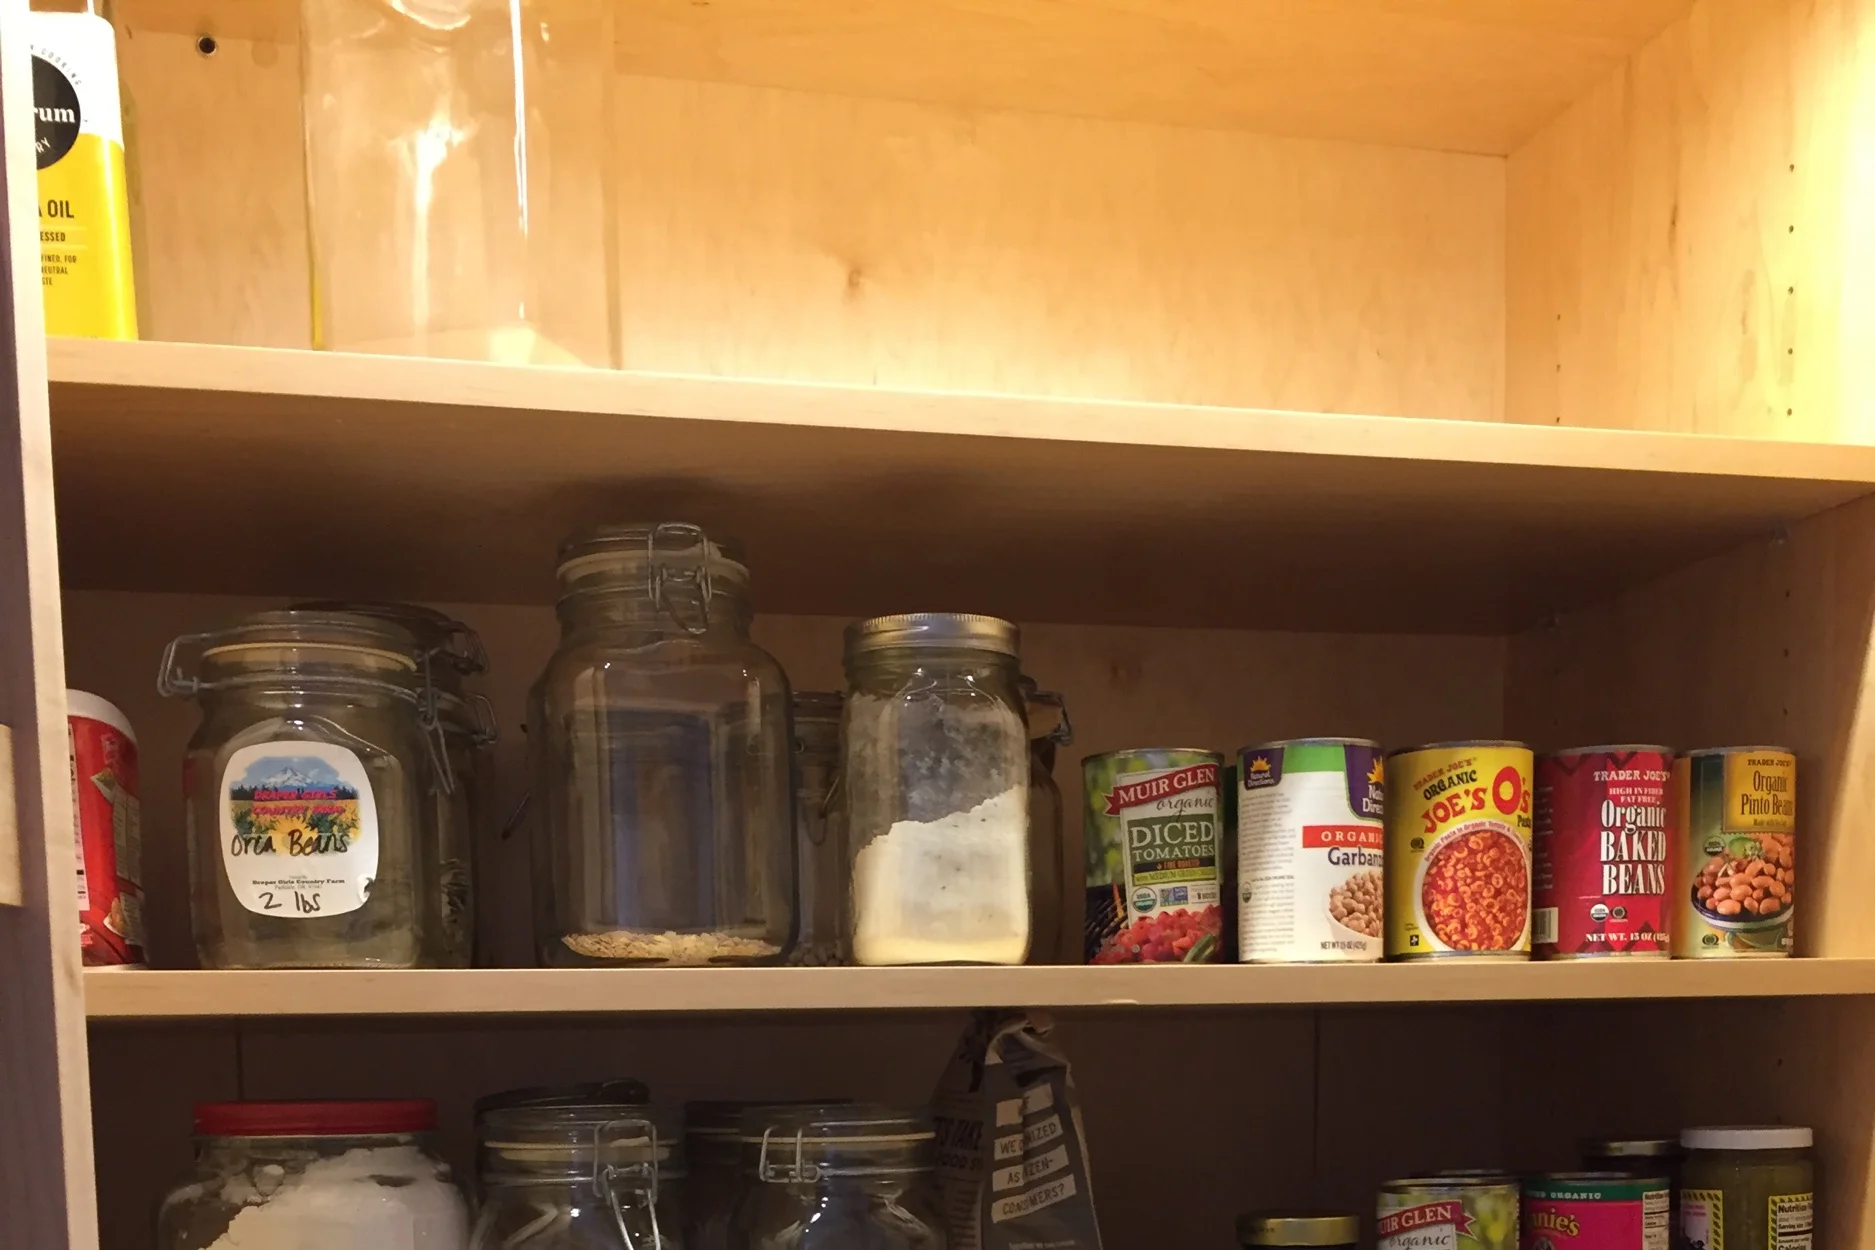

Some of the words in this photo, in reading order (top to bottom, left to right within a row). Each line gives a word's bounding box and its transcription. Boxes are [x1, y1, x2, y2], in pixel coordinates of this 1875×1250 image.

[48, 200, 75, 218] OIL
[1747, 758, 1775, 766] TRADER
[1413, 767, 1445, 792] TRADER
[1423, 770, 1478, 801] ORGANIC
[1593, 769, 1641, 781] TRADER
[1753, 770, 1787, 795] Organic
[1119, 778, 1170, 805] MUIR
[1172, 769, 1216, 789] GLEN
[1609, 786, 1633, 795] HIGH
[1156, 796, 1213, 823] organic
[1620, 795, 1636, 803] FAT
[1741, 793, 1770, 815] Pinto
[1421, 787, 1488, 834] JOE'S
[1601, 800, 1667, 835] Organic
[288, 829, 349, 856] Beans
[1130, 821, 1214, 848] DICED
[1132, 844, 1215, 862] TOMATOES
[1600, 830, 1667, 862] BAKED
[1602, 863, 1665, 896] BEANS
[258, 892, 282, 909] 2
[1586, 933, 1605, 943] NET
[1608, 932, 1628, 943] WT.
[1001, 1141, 1017, 1154] WE
[1007, 1169, 1020, 1182] AS
[1550, 1192, 1602, 1200] ORGANIC
[1401, 1205, 1452, 1227] GLEN
